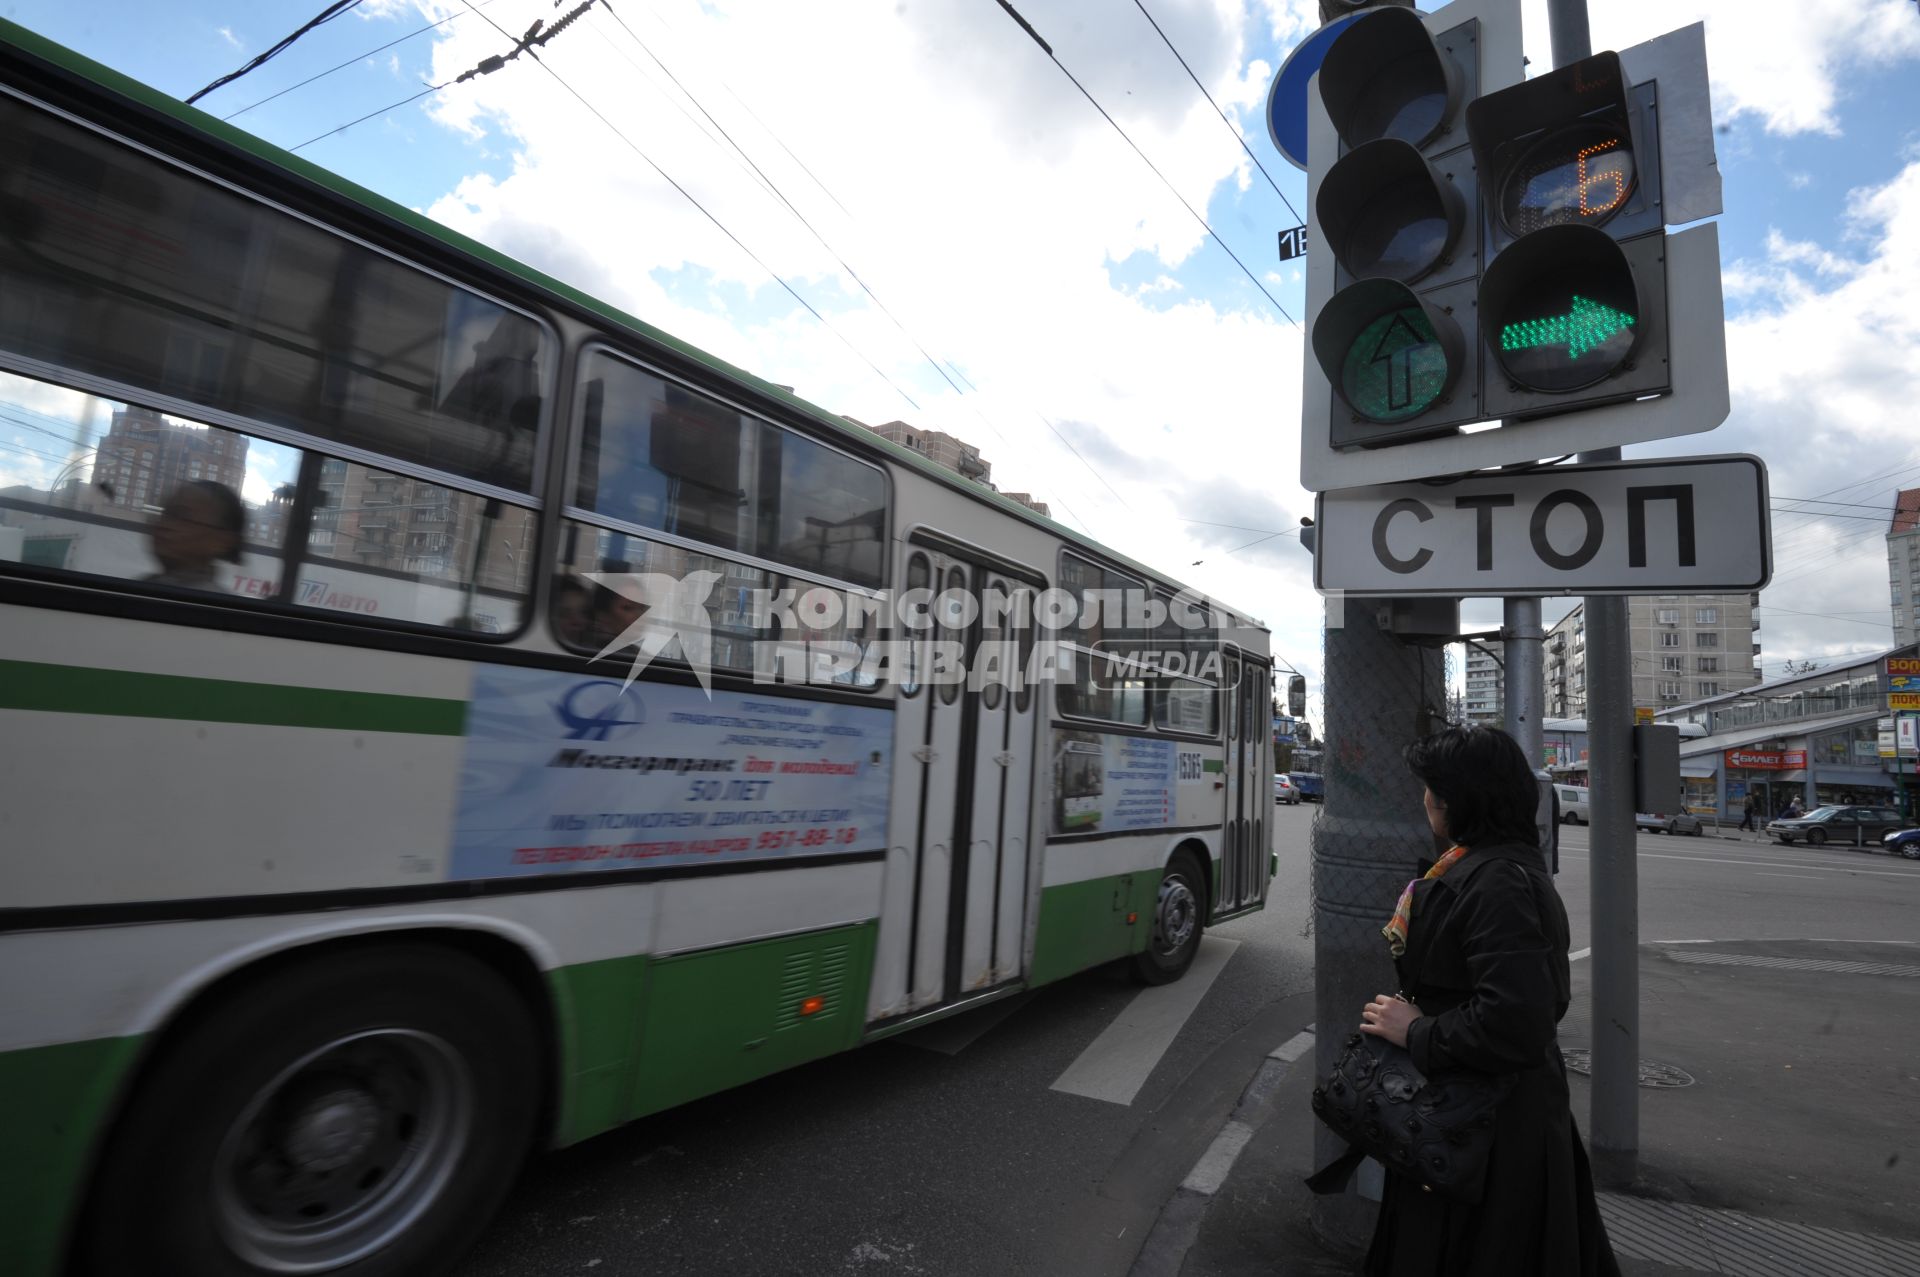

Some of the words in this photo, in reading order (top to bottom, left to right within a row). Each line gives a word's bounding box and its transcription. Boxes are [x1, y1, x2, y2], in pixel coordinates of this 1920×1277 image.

[1578, 138, 1623, 217] 6
[1371, 484, 1697, 575] СТОП
[547, 748, 737, 776] Мосгортранс
[685, 780, 722, 801] 50
[722, 780, 774, 801] ЛЕТ
[597, 812, 708, 830] ПОМОГАЕМ
[707, 810, 799, 827] ДВИГАТЬСЯ
[512, 845, 612, 865] ТЕЛЕФОН
[613, 840, 687, 859] ОТДЕЛА
[688, 837, 752, 856] КАДРОВ
